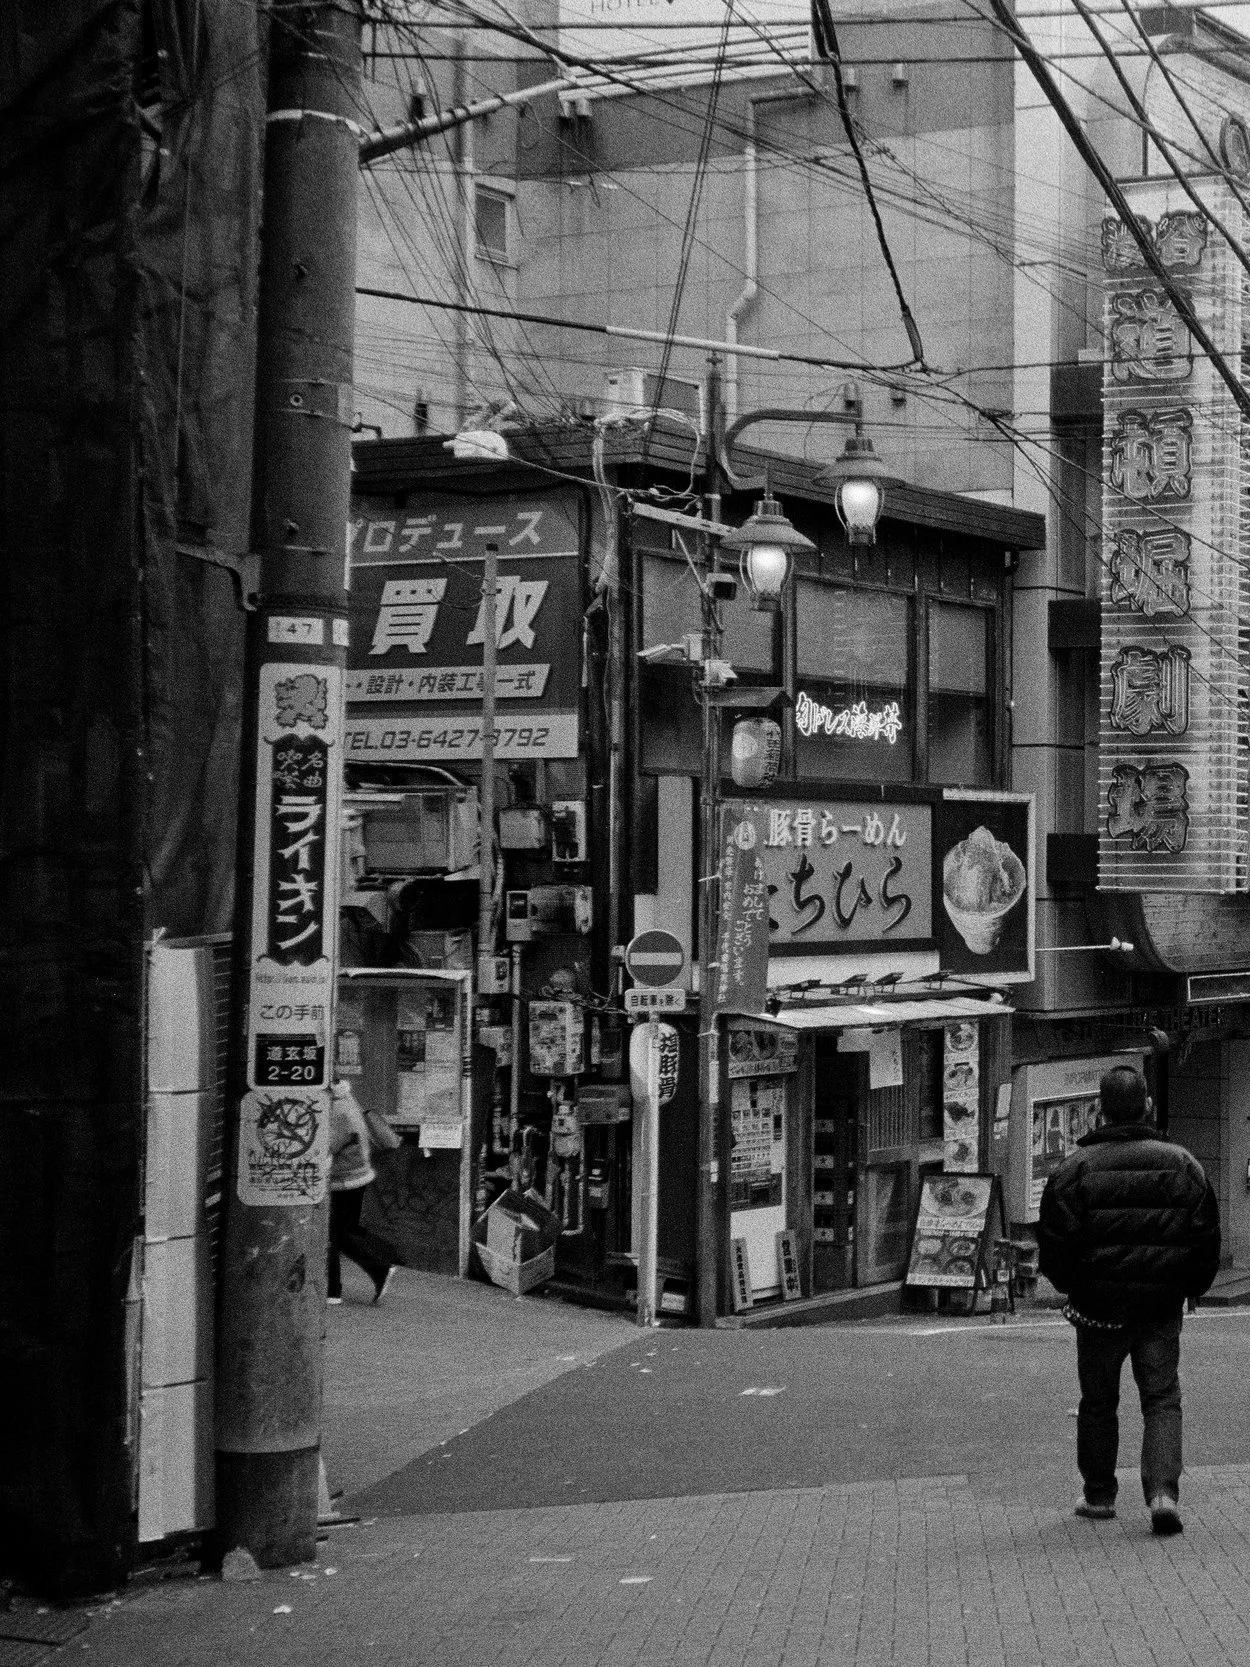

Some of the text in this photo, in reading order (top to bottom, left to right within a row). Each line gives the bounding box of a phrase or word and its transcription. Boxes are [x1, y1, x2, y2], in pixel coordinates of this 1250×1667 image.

[367, 575, 550, 656] 買取
[275, 795, 323, 949] ライオン
[260, 1005, 325, 1021] この手前
[266, 1046, 317, 1061] 道玄坂
[267, 1065, 316, 1080] 2-20
